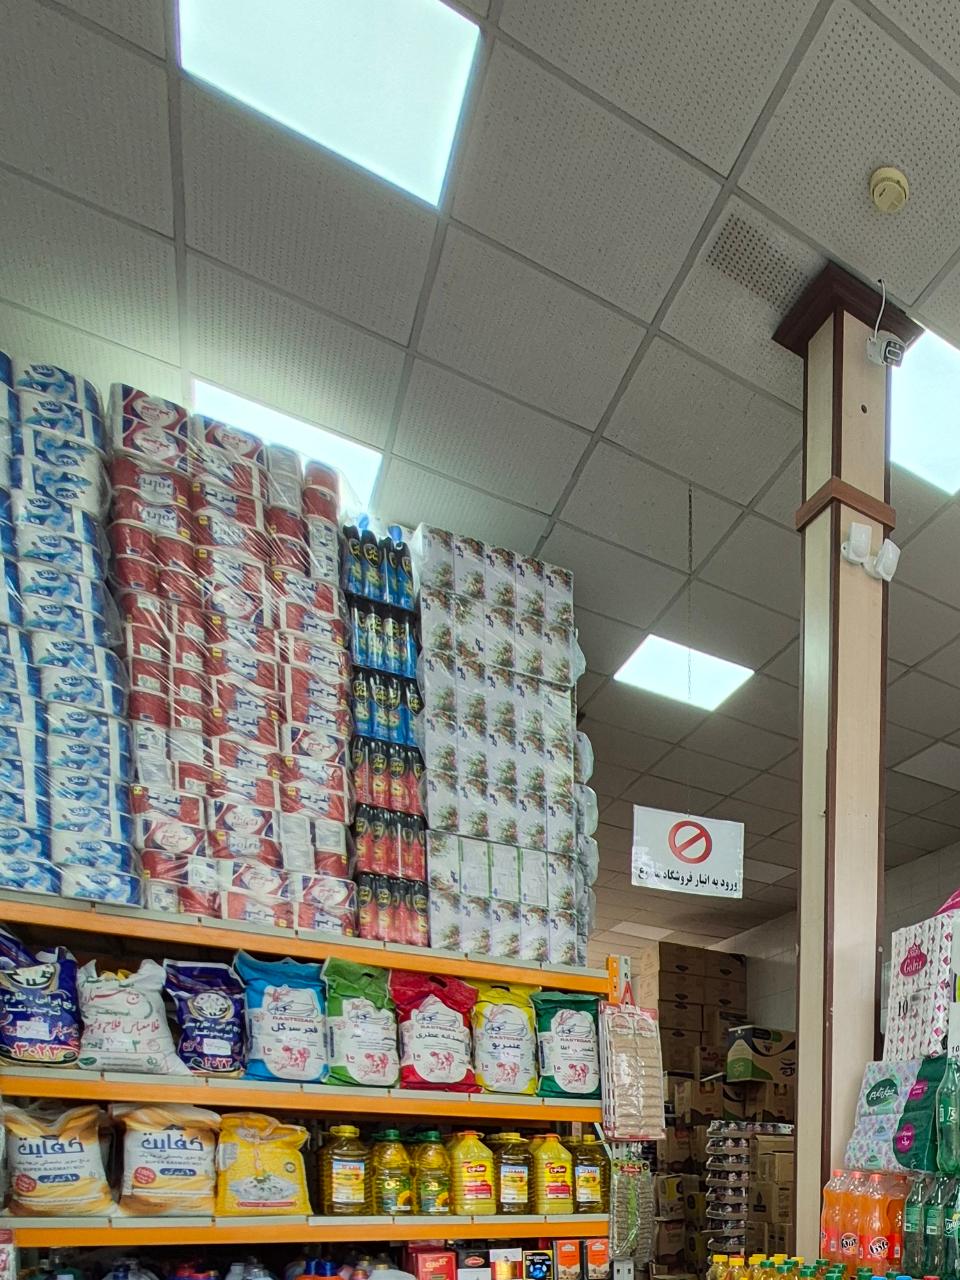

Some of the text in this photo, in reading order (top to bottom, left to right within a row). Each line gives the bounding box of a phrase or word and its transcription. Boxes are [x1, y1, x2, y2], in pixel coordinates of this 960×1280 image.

[694, 873, 710, 888] انبار
[711, 877, 719, 889] به
[720, 878, 738, 892] ورود
